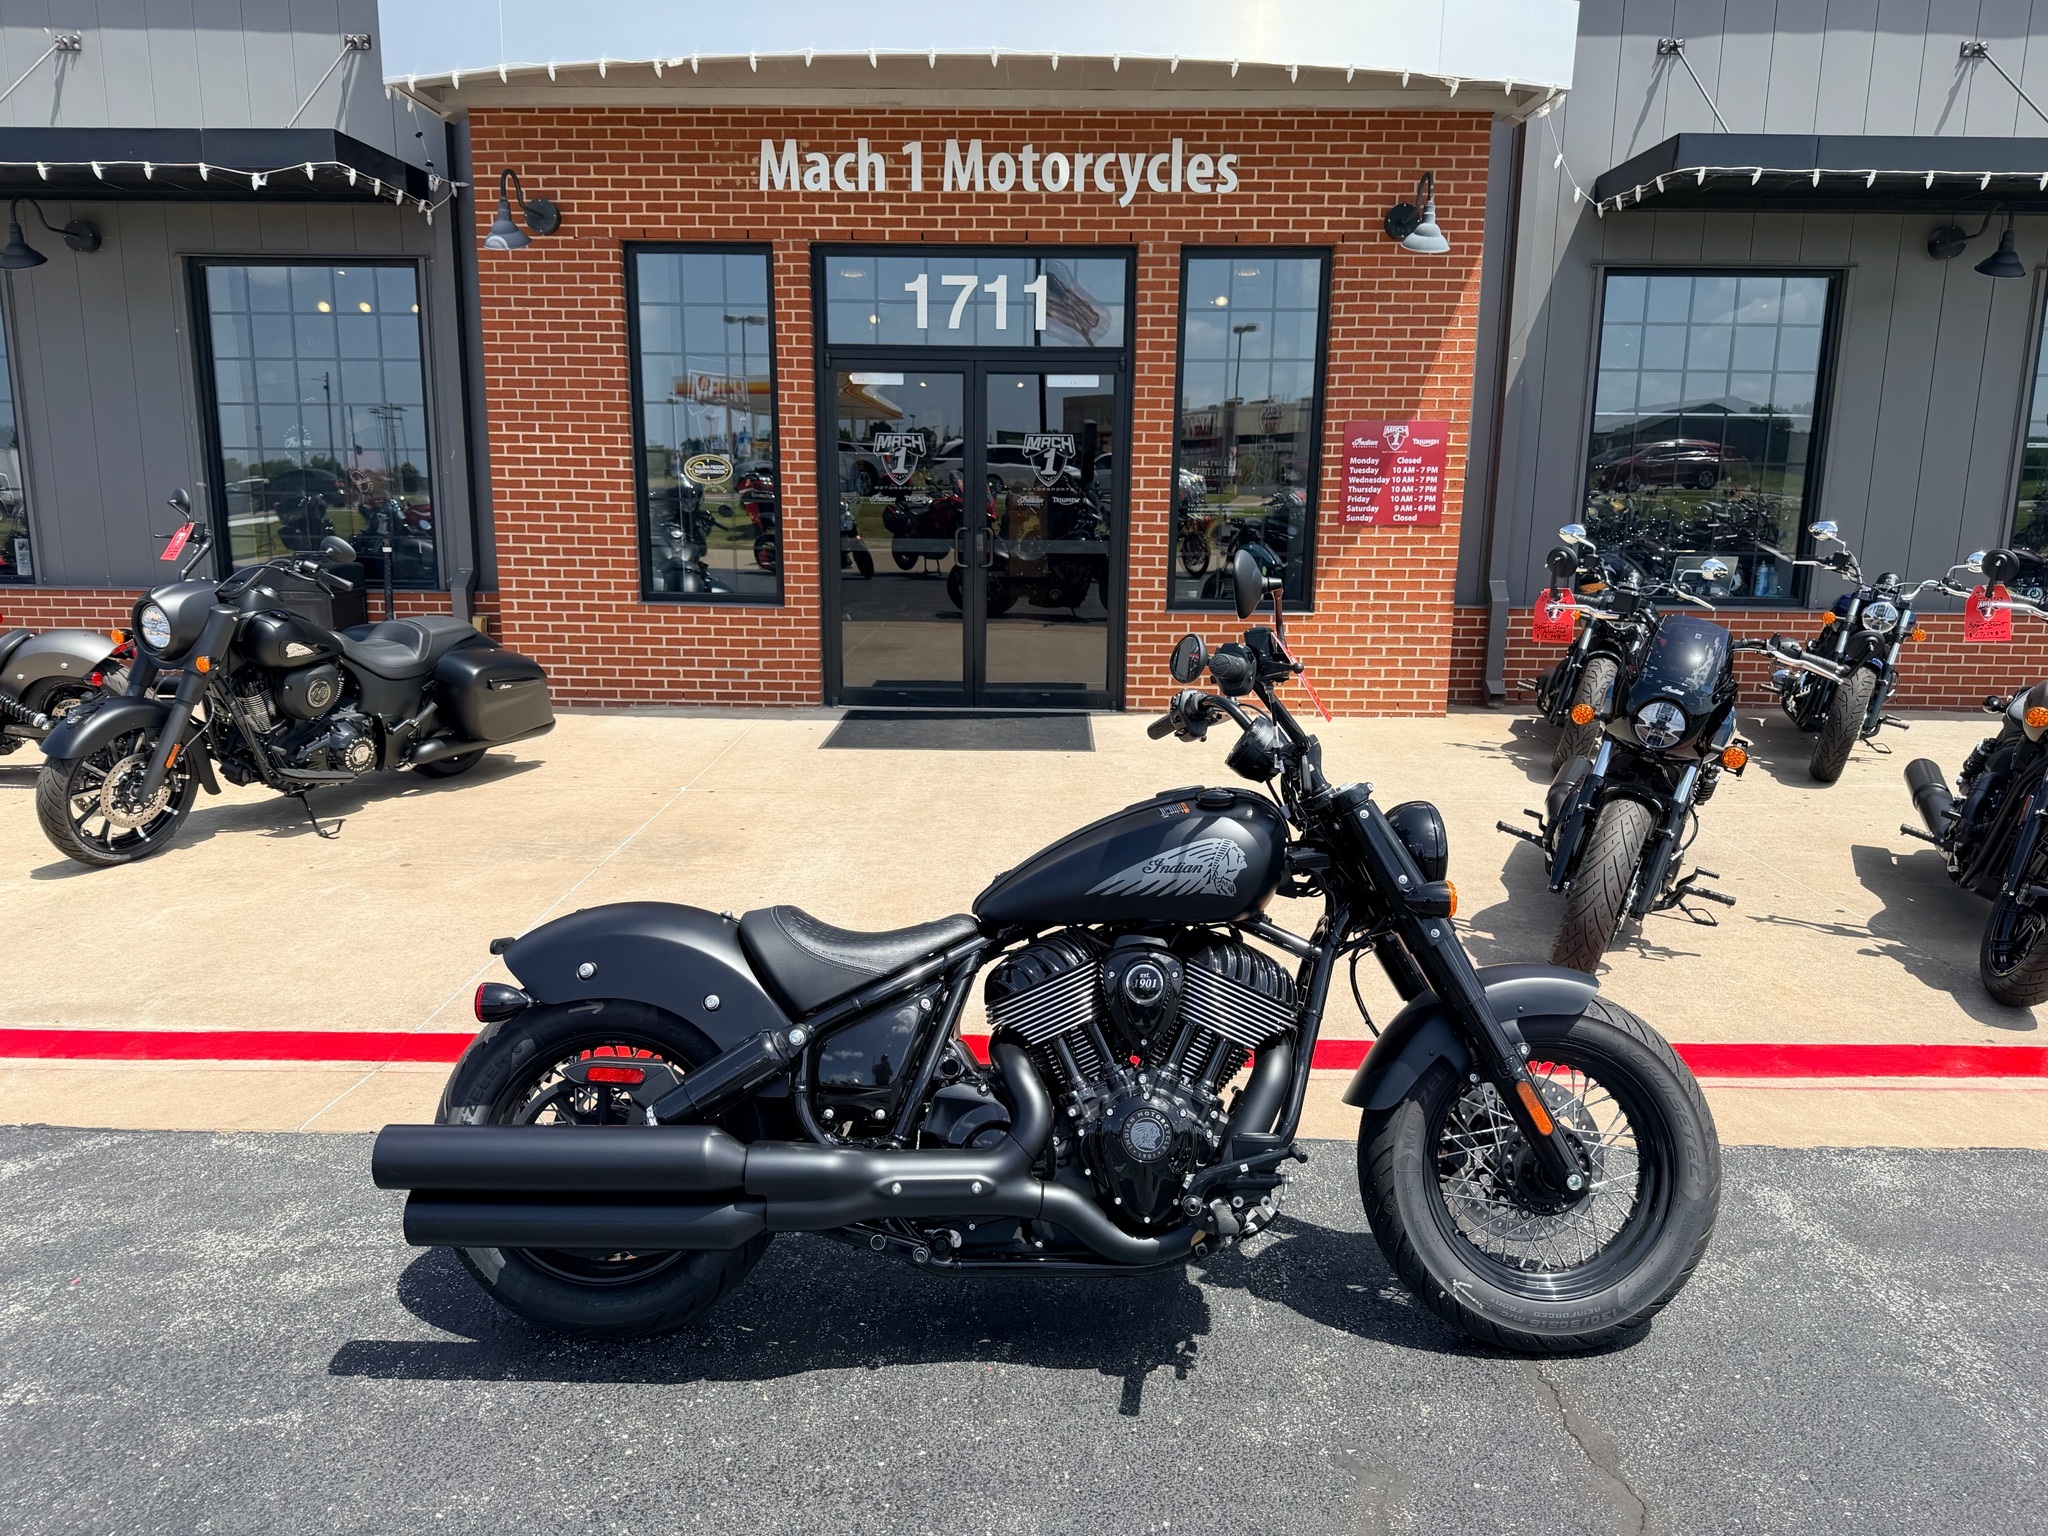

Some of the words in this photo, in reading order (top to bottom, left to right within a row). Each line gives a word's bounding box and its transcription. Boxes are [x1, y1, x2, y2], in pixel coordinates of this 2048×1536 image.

[759, 138, 887, 192] Mach
[902, 141, 922, 192] 1
[943, 138, 1238, 208] Motorcycles
[905, 274, 1048, 331] 1711
[1384, 426, 1409, 435] MACH
[876, 435, 924, 452] MACH
[1352, 438, 1378, 446] Indian
[1391, 432, 1400, 446] 1
[1412, 438, 1440, 446] TRIUMPH
[1025, 437, 1073, 453] MACH
[892, 447, 909, 473] 1
[1040, 448, 1057, 475] 1
[1350, 457, 1380, 465] Monday
[1349, 467, 1379, 475] Tuesday
[1348, 476, 1390, 484] Wednesday
[1348, 486, 1381, 494] Thursday
[1347, 496, 1370, 504] Friday
[1346, 505, 1379, 513] Saturday
[1346, 514, 1373, 523] Sunday
[1142, 858, 1202, 874] Indian
[1134, 979, 1157, 988] 1901
[1125, 1117, 1135, 1149] INDIAN
[1138, 1111, 1170, 1150] MOTORCYCLE
[1534, 1306, 1601, 1319] REINFORCED
